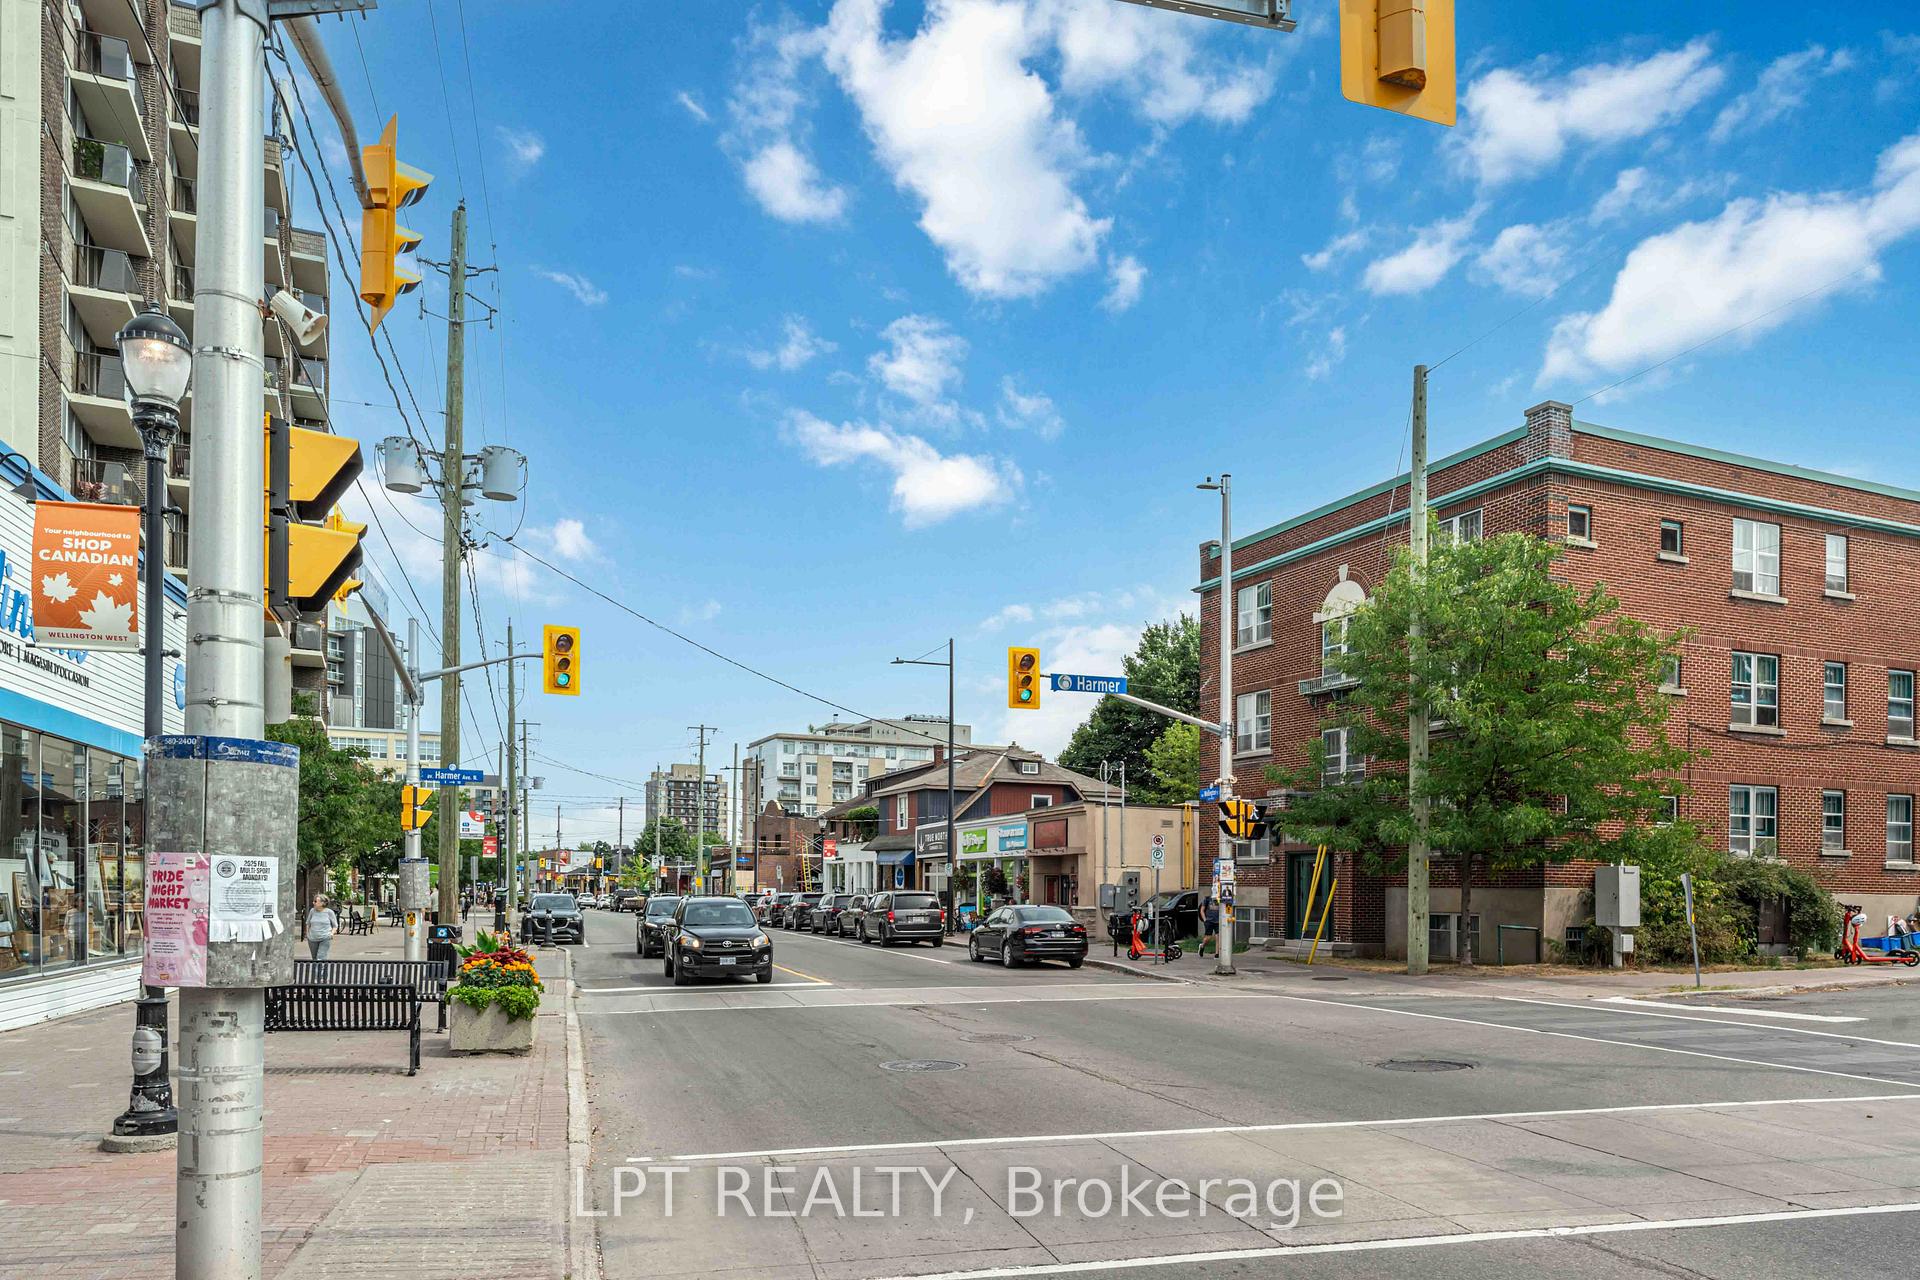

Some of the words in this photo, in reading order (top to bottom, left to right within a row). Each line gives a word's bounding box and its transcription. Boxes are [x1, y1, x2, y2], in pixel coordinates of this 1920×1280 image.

[44, 527, 62, 535] Your
[63, 529, 121, 539] neighbourhood
[62, 537, 112, 551] SHOP
[38, 548, 134, 567] CANADIAN
[48, 631, 103, 640] WELLINGTON
[105, 634, 128, 642] WEST
[1077, 676, 1120, 693] Harmer
[435, 770, 461, 780] Harmer
[152, 869, 185, 883] PRIDE
[152, 884, 185, 896] NIGHT
[148, 897, 190, 910] MARKET
